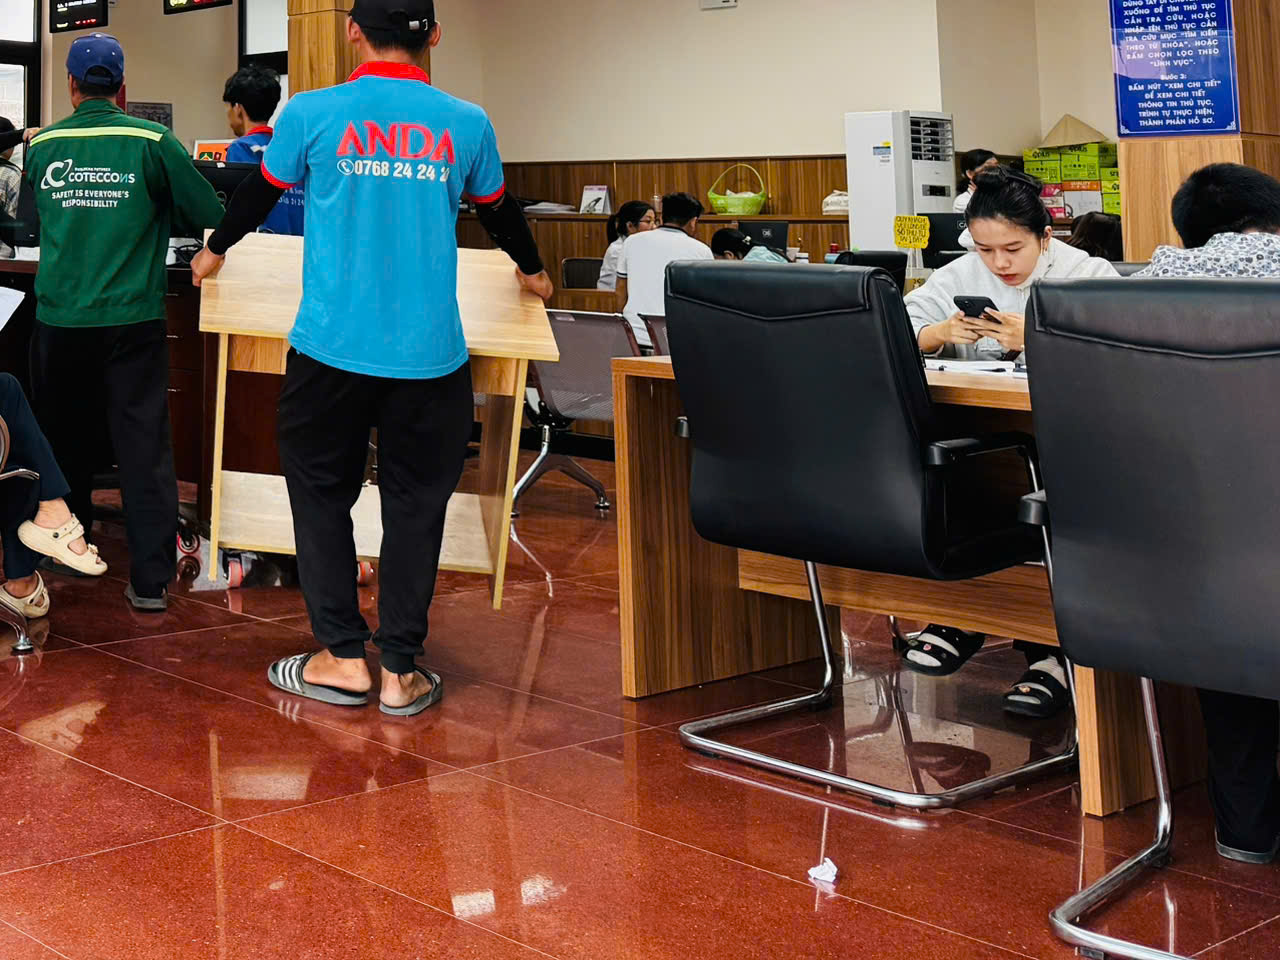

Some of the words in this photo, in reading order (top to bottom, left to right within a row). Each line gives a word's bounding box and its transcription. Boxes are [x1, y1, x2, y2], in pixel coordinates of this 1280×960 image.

[336, 121, 456, 164] ANDA
[354, 160, 389, 176] 0768
[393, 162, 412, 178] 24
[417, 164, 435, 180] 24
[69, 172, 135, 183] COTECCONS
[52, 190, 74, 199] SAFETY
[85, 190, 129, 198] EVERYONE'S
[62, 199, 118, 207] RESPONSIBILITY
